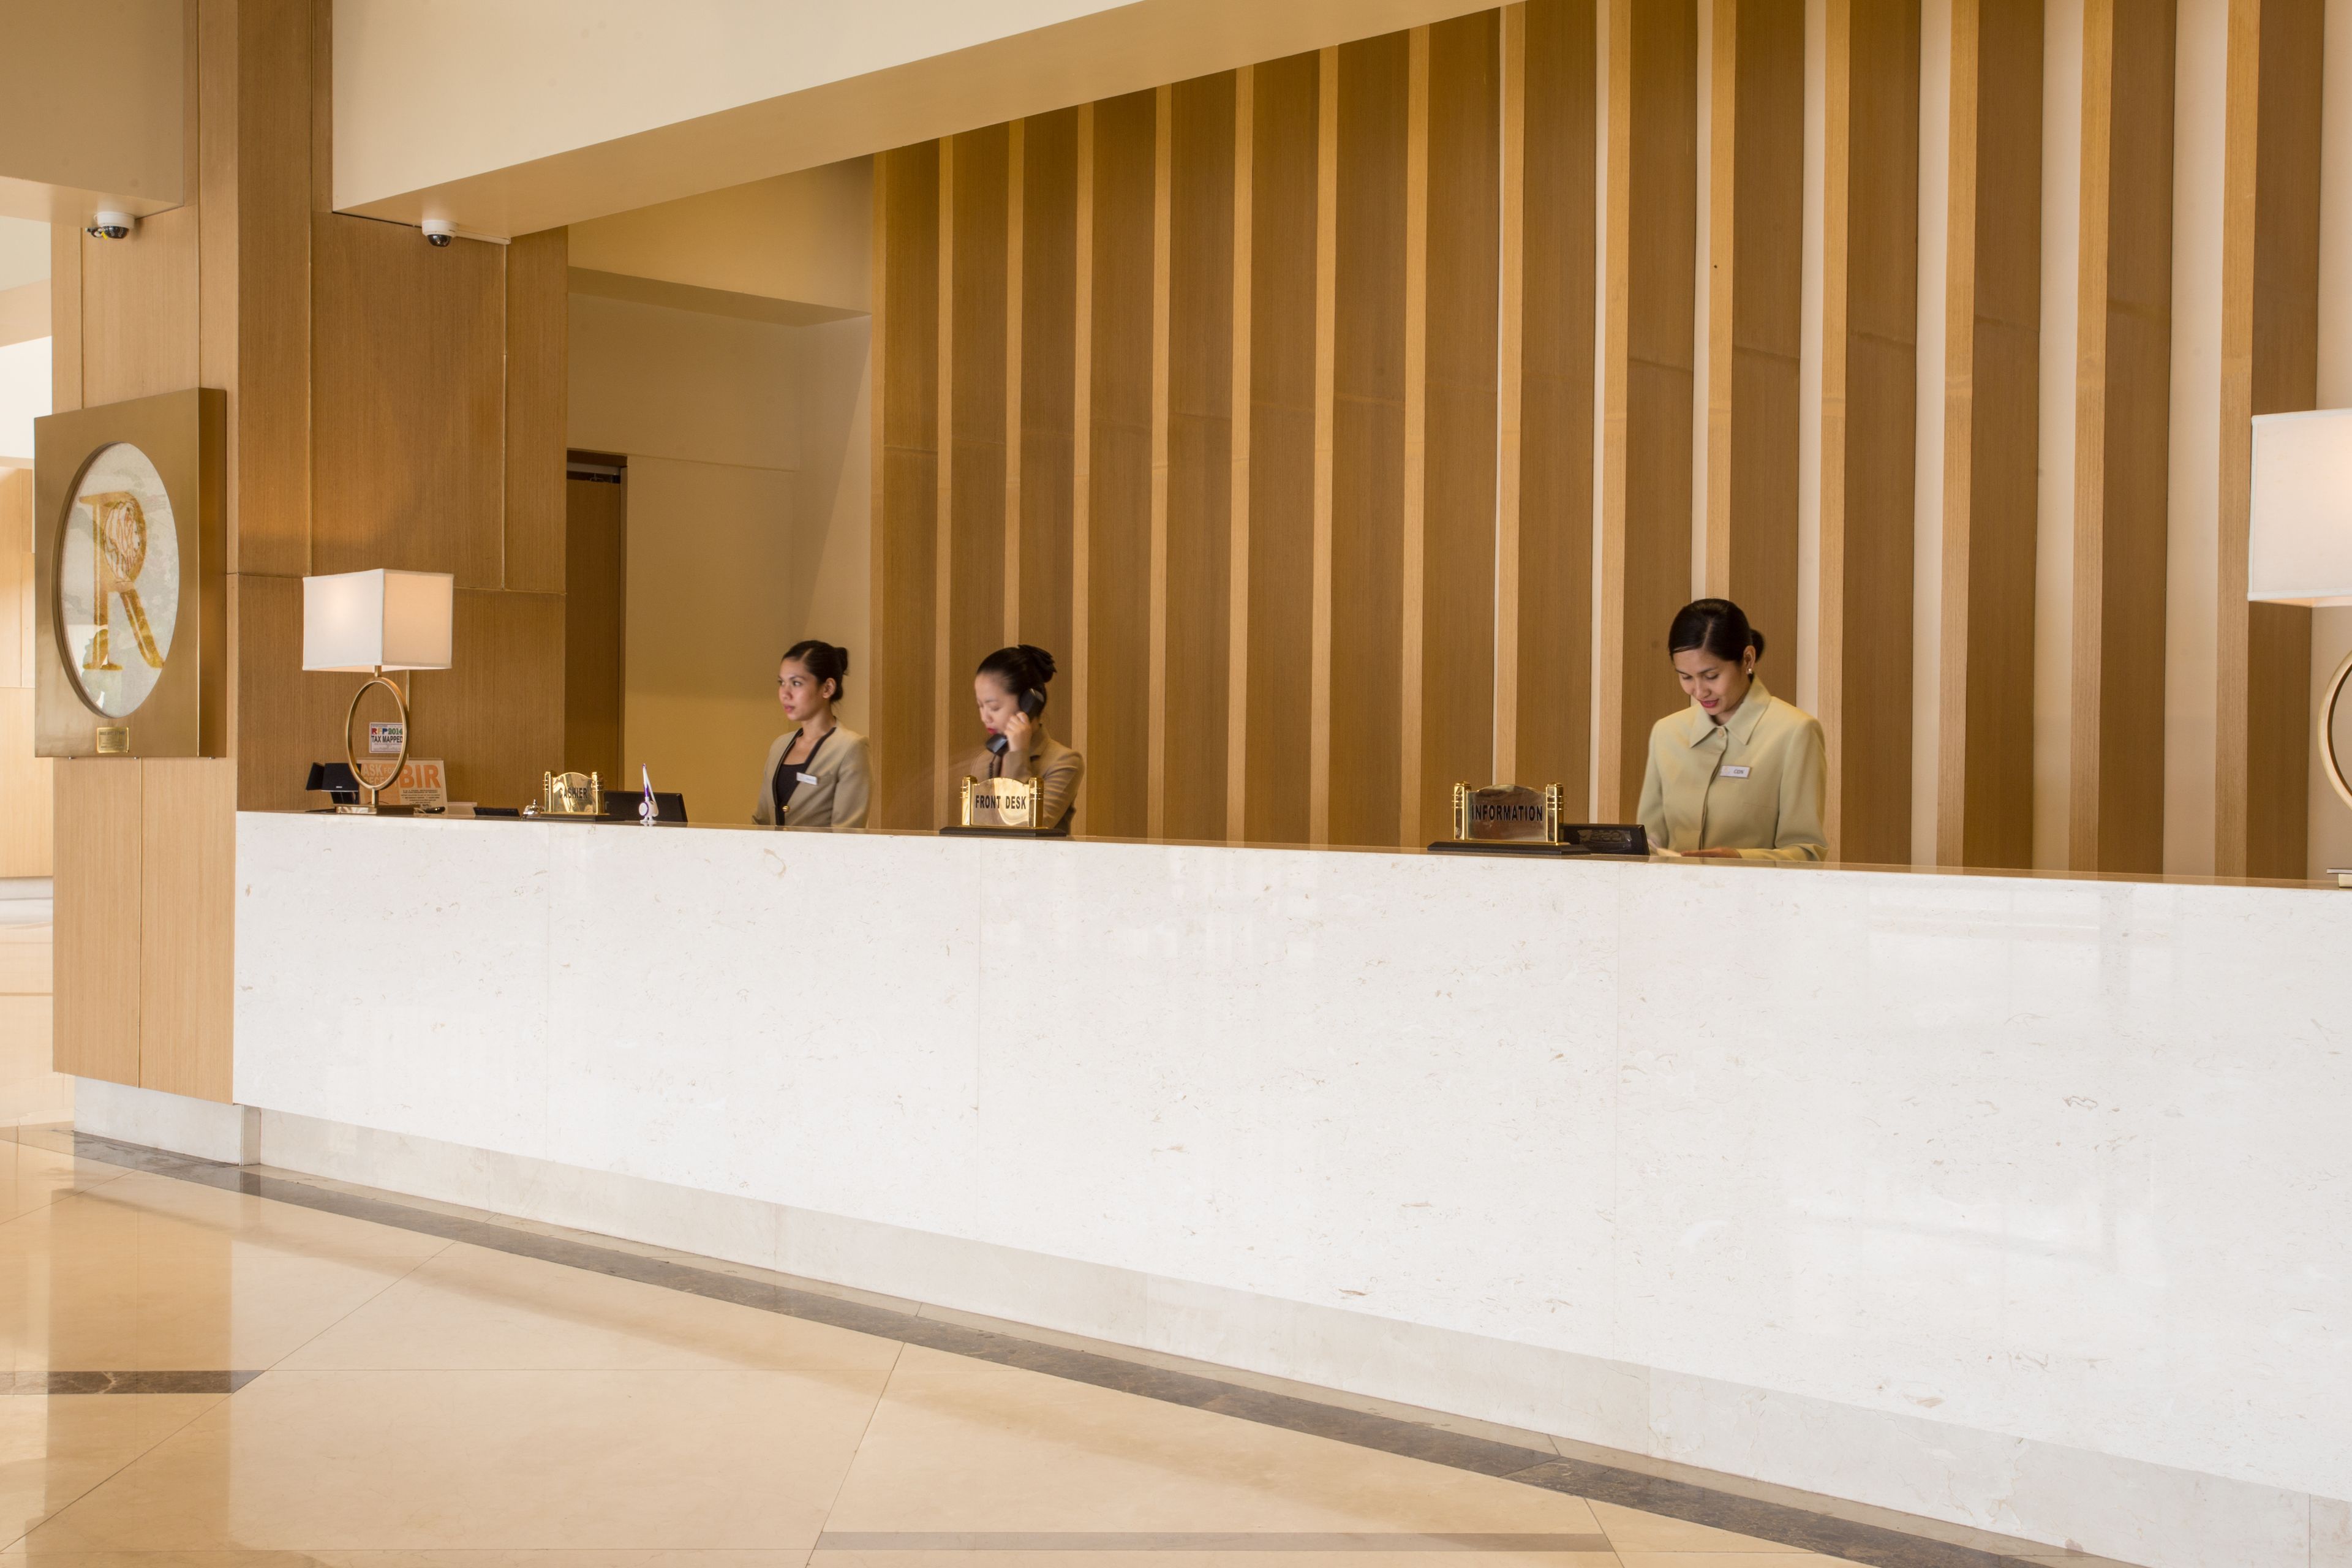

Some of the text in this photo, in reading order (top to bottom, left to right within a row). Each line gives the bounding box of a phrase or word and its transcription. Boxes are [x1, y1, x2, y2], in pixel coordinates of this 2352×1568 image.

[80, 492, 165, 670] R
[363, 764, 383, 777] ASK
[399, 764, 441, 788] BIR
[975, 795, 1027, 809] FRONT DESK
[1471, 804, 1543, 821] INFORMATION
